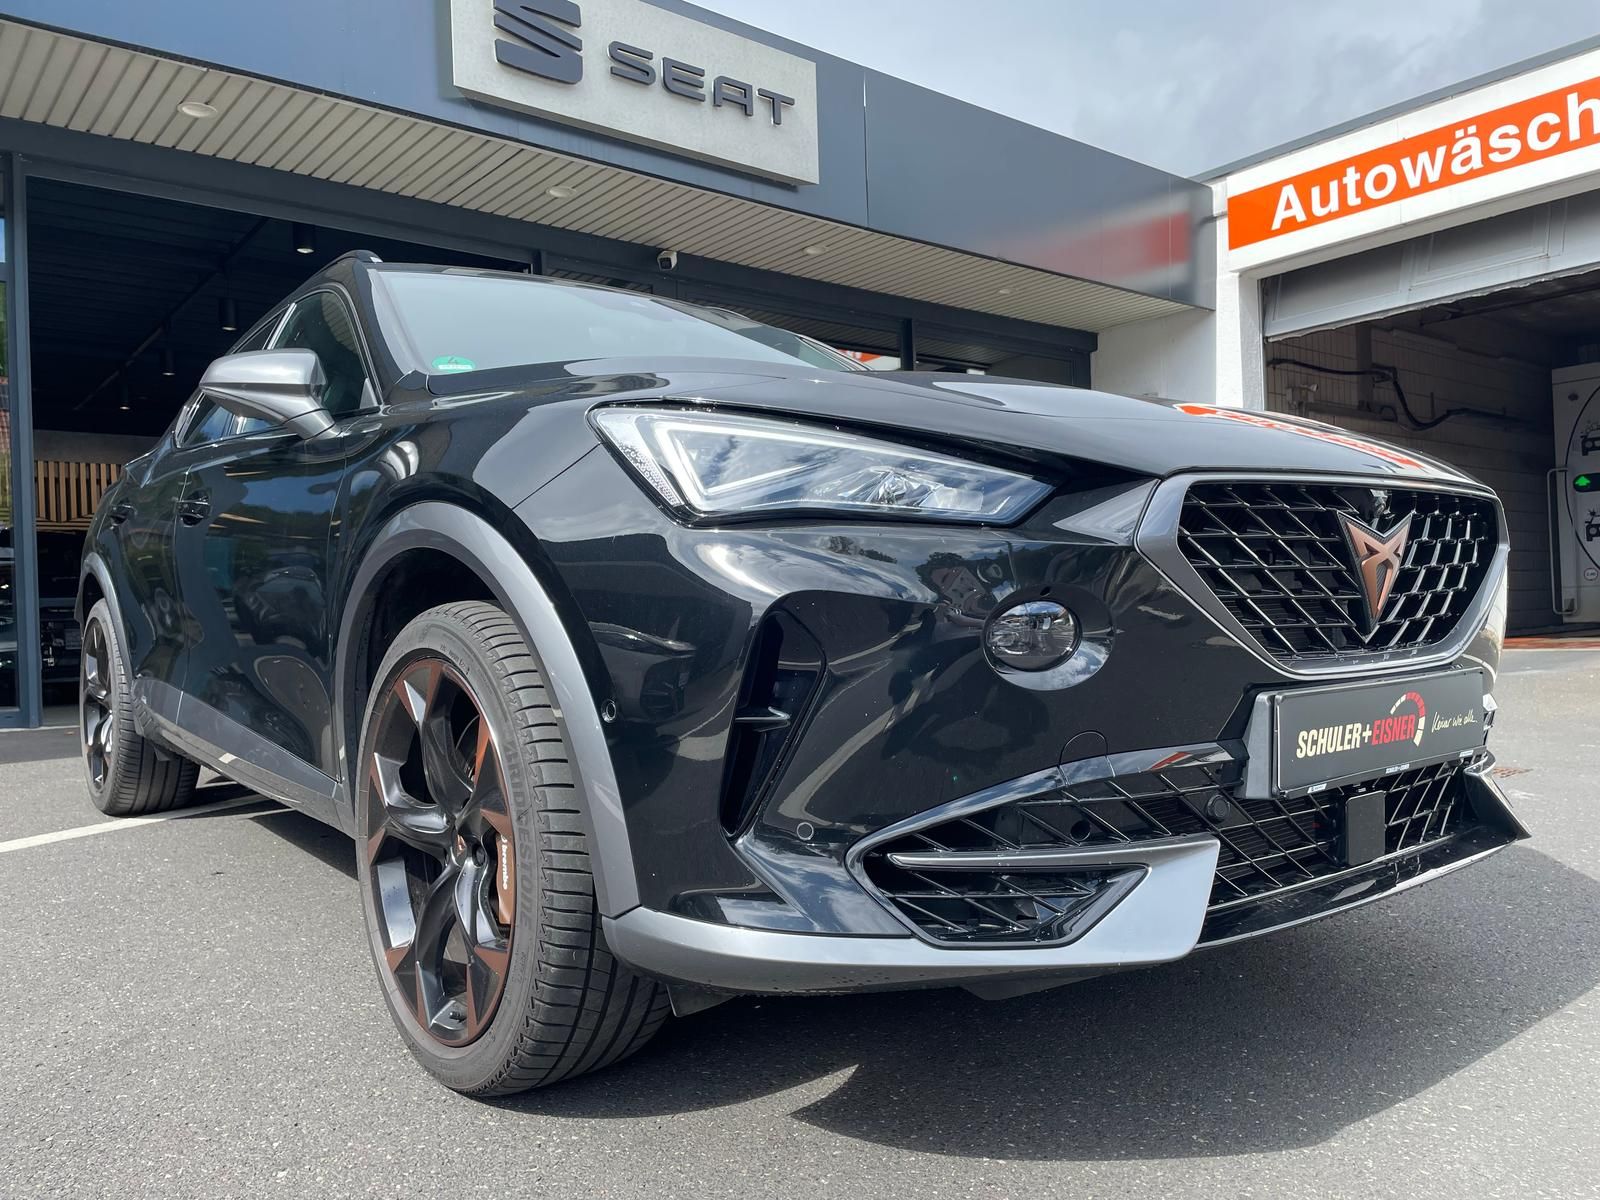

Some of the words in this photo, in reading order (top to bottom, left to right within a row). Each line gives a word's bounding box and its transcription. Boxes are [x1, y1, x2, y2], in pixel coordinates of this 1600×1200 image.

[607, 41, 796, 126] SEAT
[1271, 92, 1600, 230] Autowäsch
[1296, 714, 1416, 758] SCHULER+EISNER
